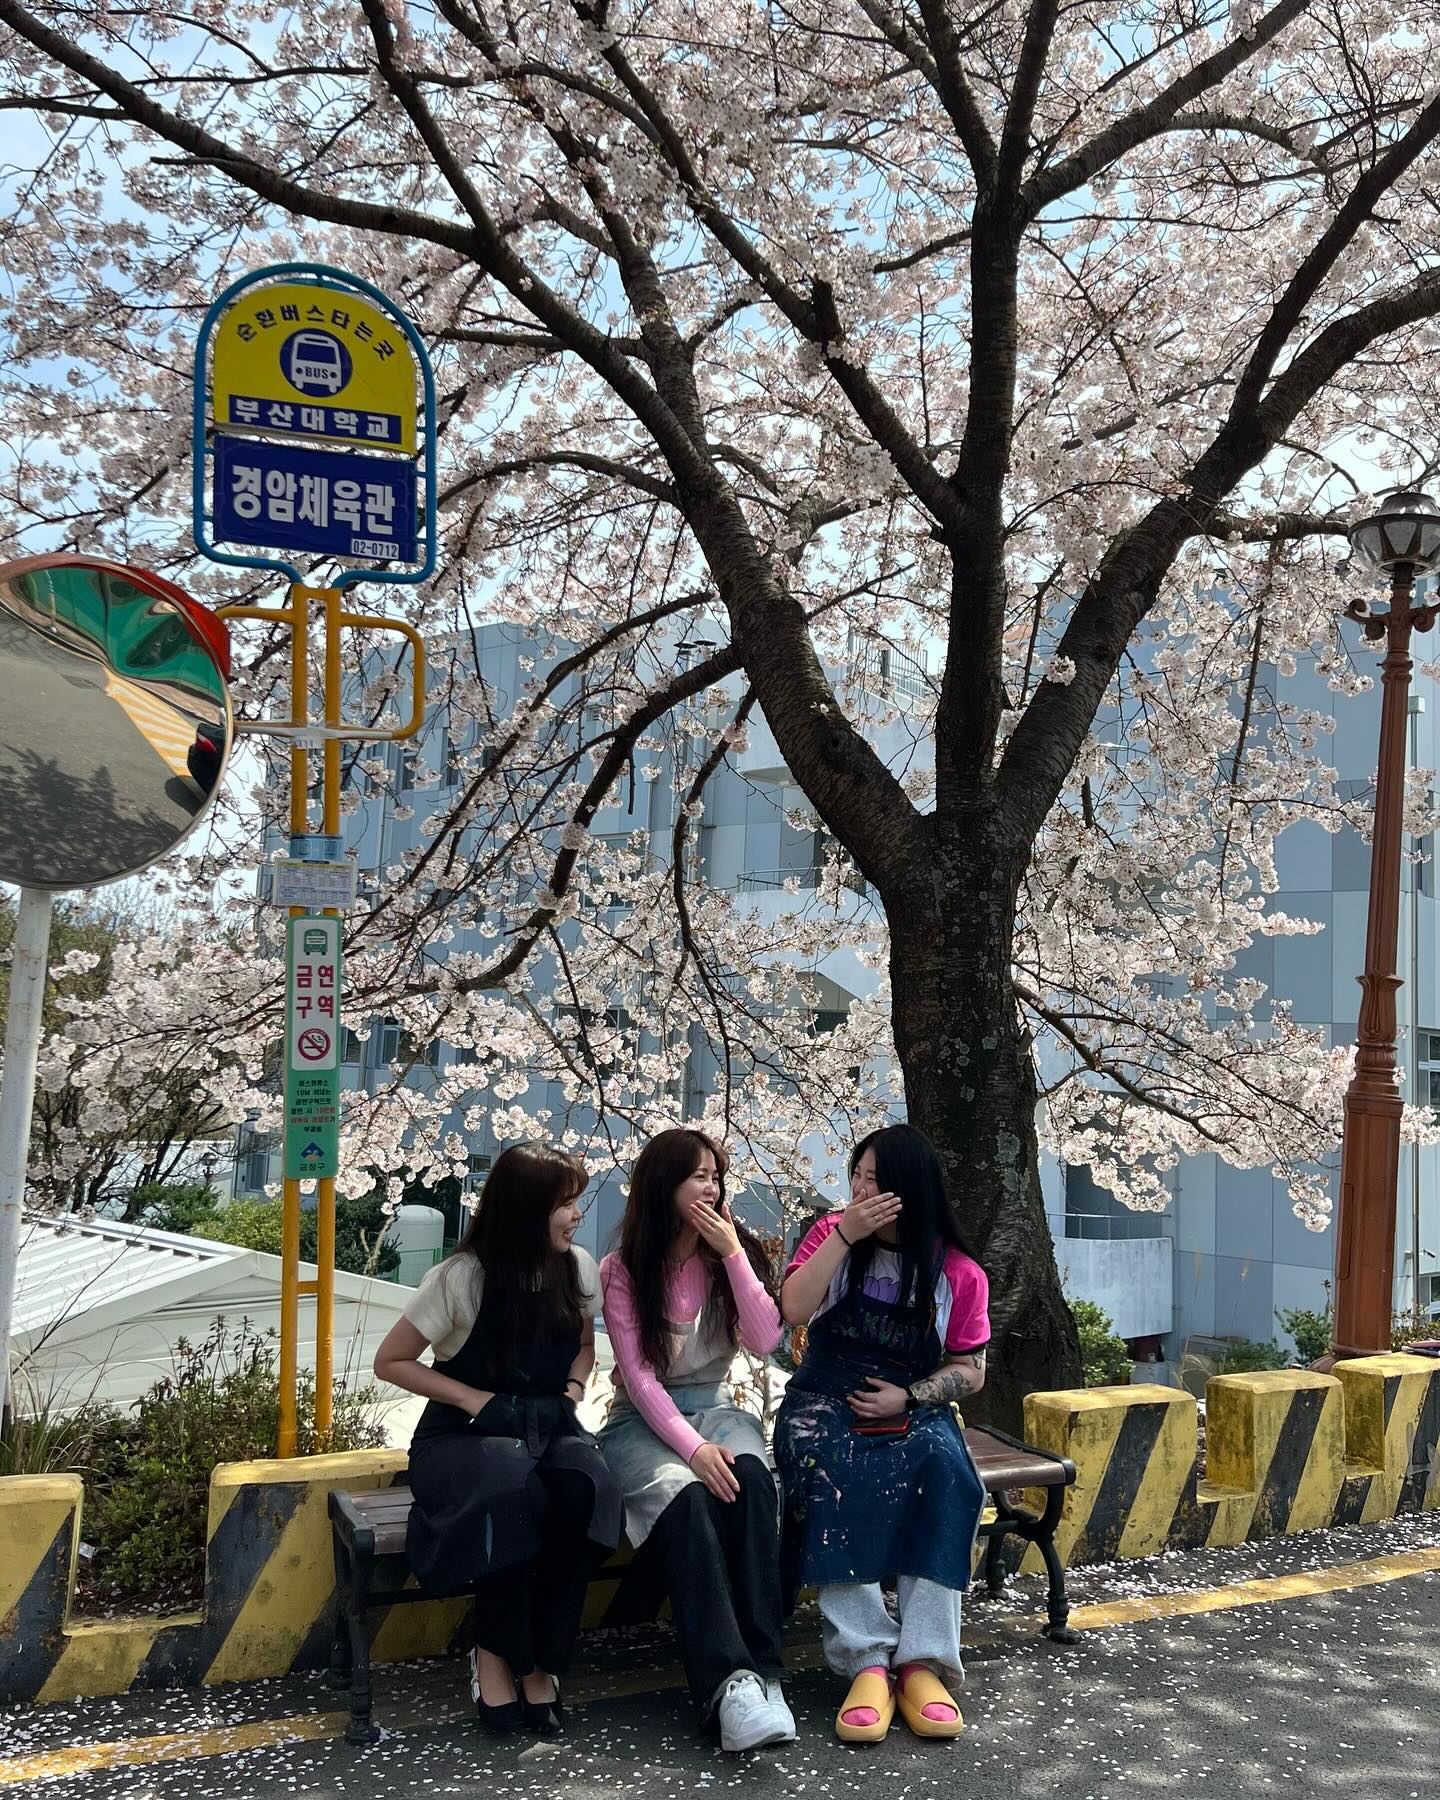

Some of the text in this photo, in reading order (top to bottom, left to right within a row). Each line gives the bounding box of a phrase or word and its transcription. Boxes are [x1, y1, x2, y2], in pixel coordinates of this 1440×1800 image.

[304, 365, 330, 379] BUS
[235, 399, 390, 439] 부산대학교
[231, 464, 396, 536] 경암체육관
[352, 541, 399, 559] 02-0712
[296, 965, 335, 988] 금연
[295, 995, 335, 1019] 구역
